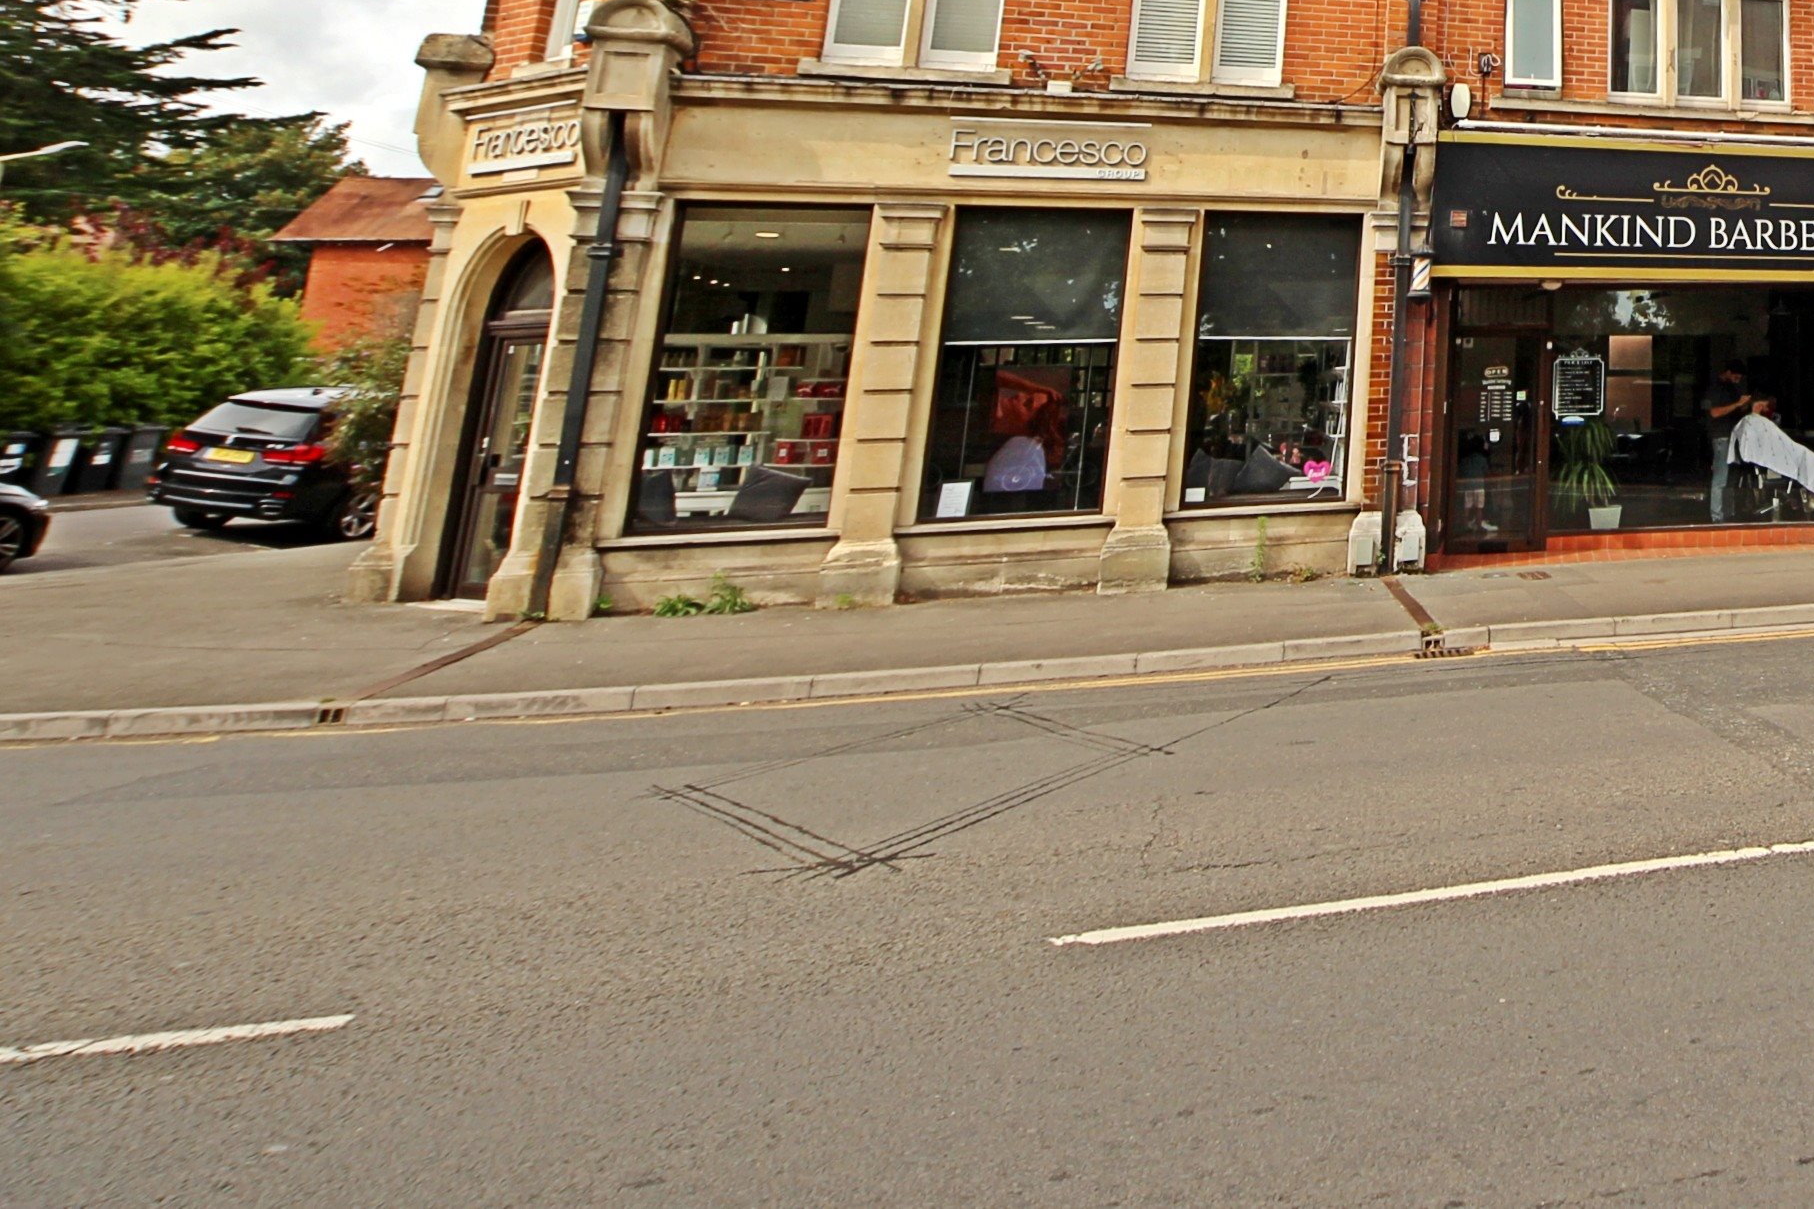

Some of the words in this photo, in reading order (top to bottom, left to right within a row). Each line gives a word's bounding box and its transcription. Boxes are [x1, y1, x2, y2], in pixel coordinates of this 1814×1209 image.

[472, 120, 580, 163] Francesco
[950, 129, 1147, 166] Francesco
[1097, 169, 1141, 179] GROUP
[1487, 211, 1696, 249] MANKIND
